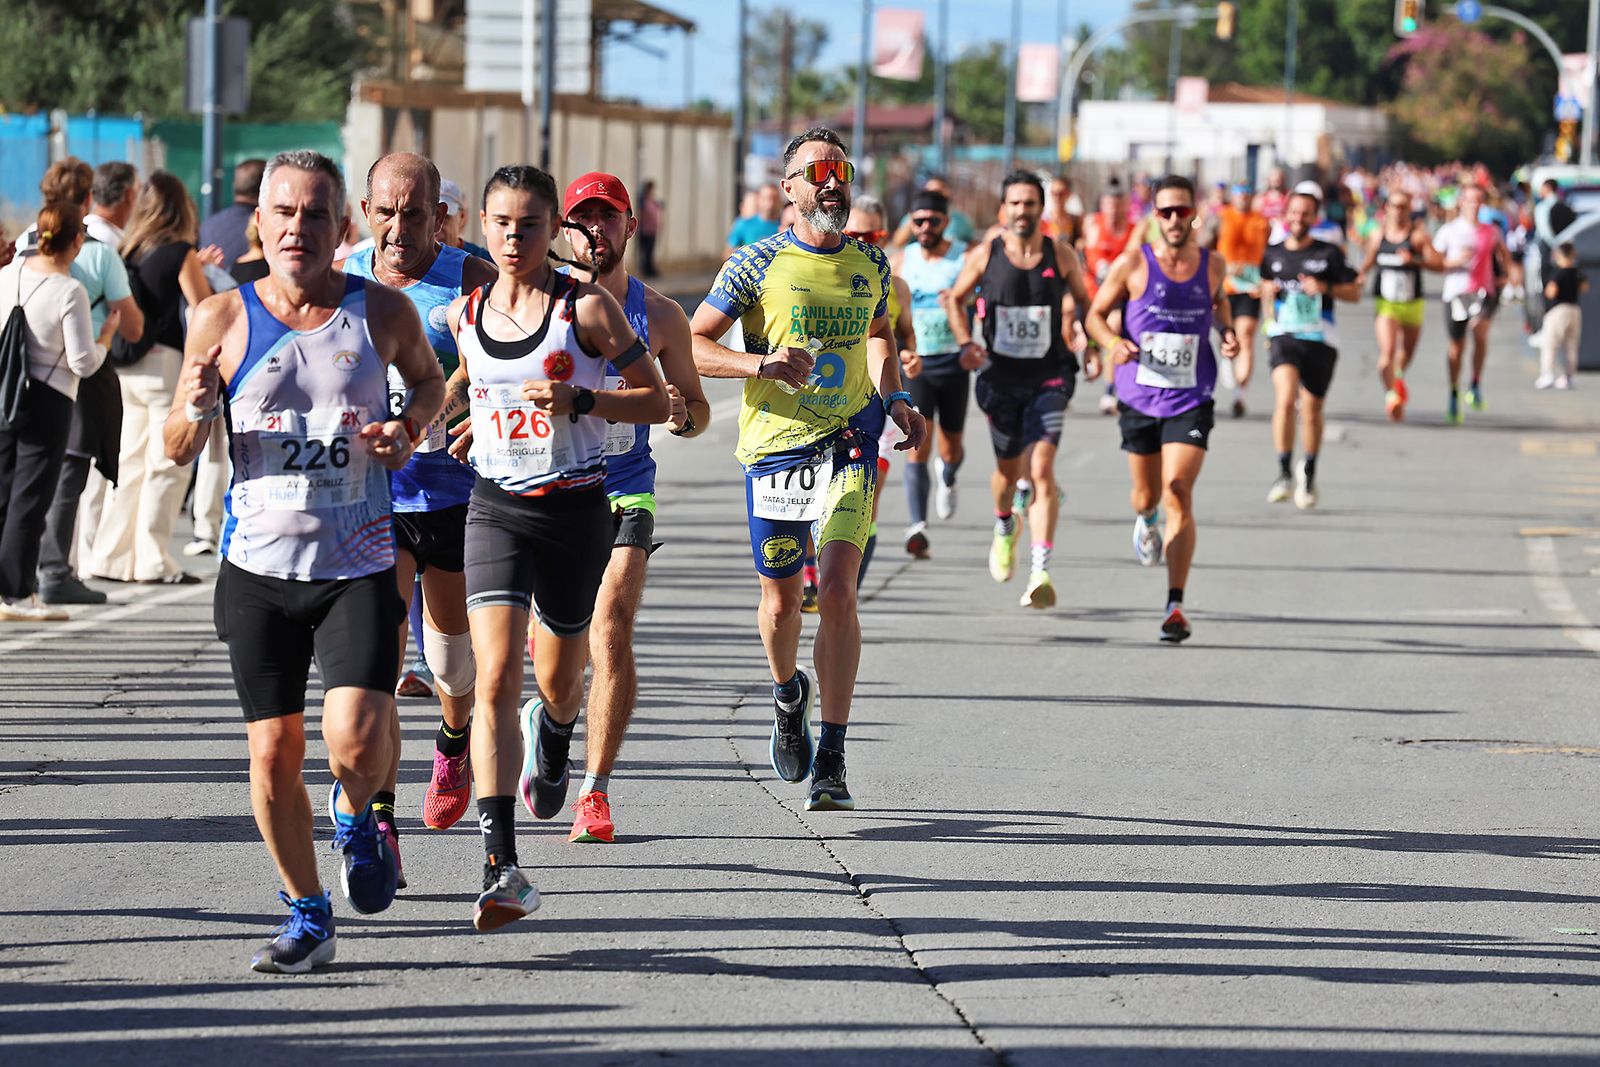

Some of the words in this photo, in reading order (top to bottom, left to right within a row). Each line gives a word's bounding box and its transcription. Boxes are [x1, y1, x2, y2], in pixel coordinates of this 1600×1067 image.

[791, 305, 853, 319] CANILLAS
[856, 306, 869, 320] DE
[789, 319, 867, 337] ALBAIDA
[1008, 321, 1040, 339] 183
[1145, 349, 1193, 367] 1339
[798, 393, 848, 408] axaragua
[490, 409, 551, 440] 126
[281, 436, 350, 472] 226
[315, 477, 344, 488] CRUZ
[786, 497, 816, 506] TELLEZ
